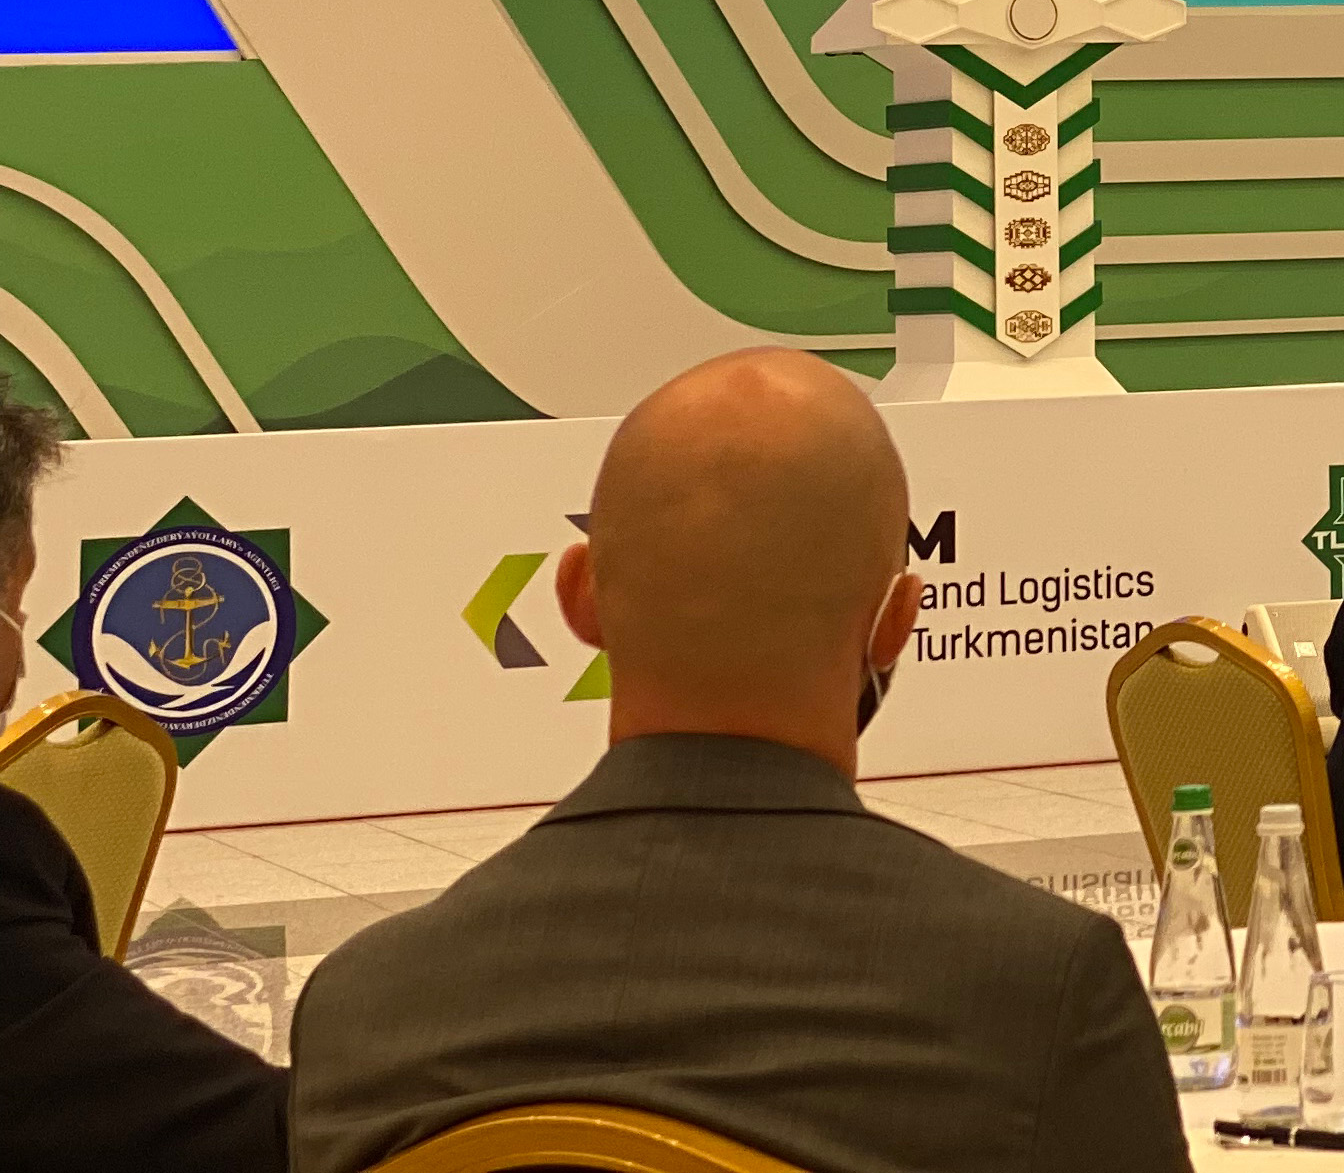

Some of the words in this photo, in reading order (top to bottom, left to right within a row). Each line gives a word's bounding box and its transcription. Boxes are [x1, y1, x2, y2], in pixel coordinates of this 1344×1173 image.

[919, 572, 985, 610] and
[1000, 565, 1154, 612] Logistics
[911, 617, 1154, 662] Turkmenistan
